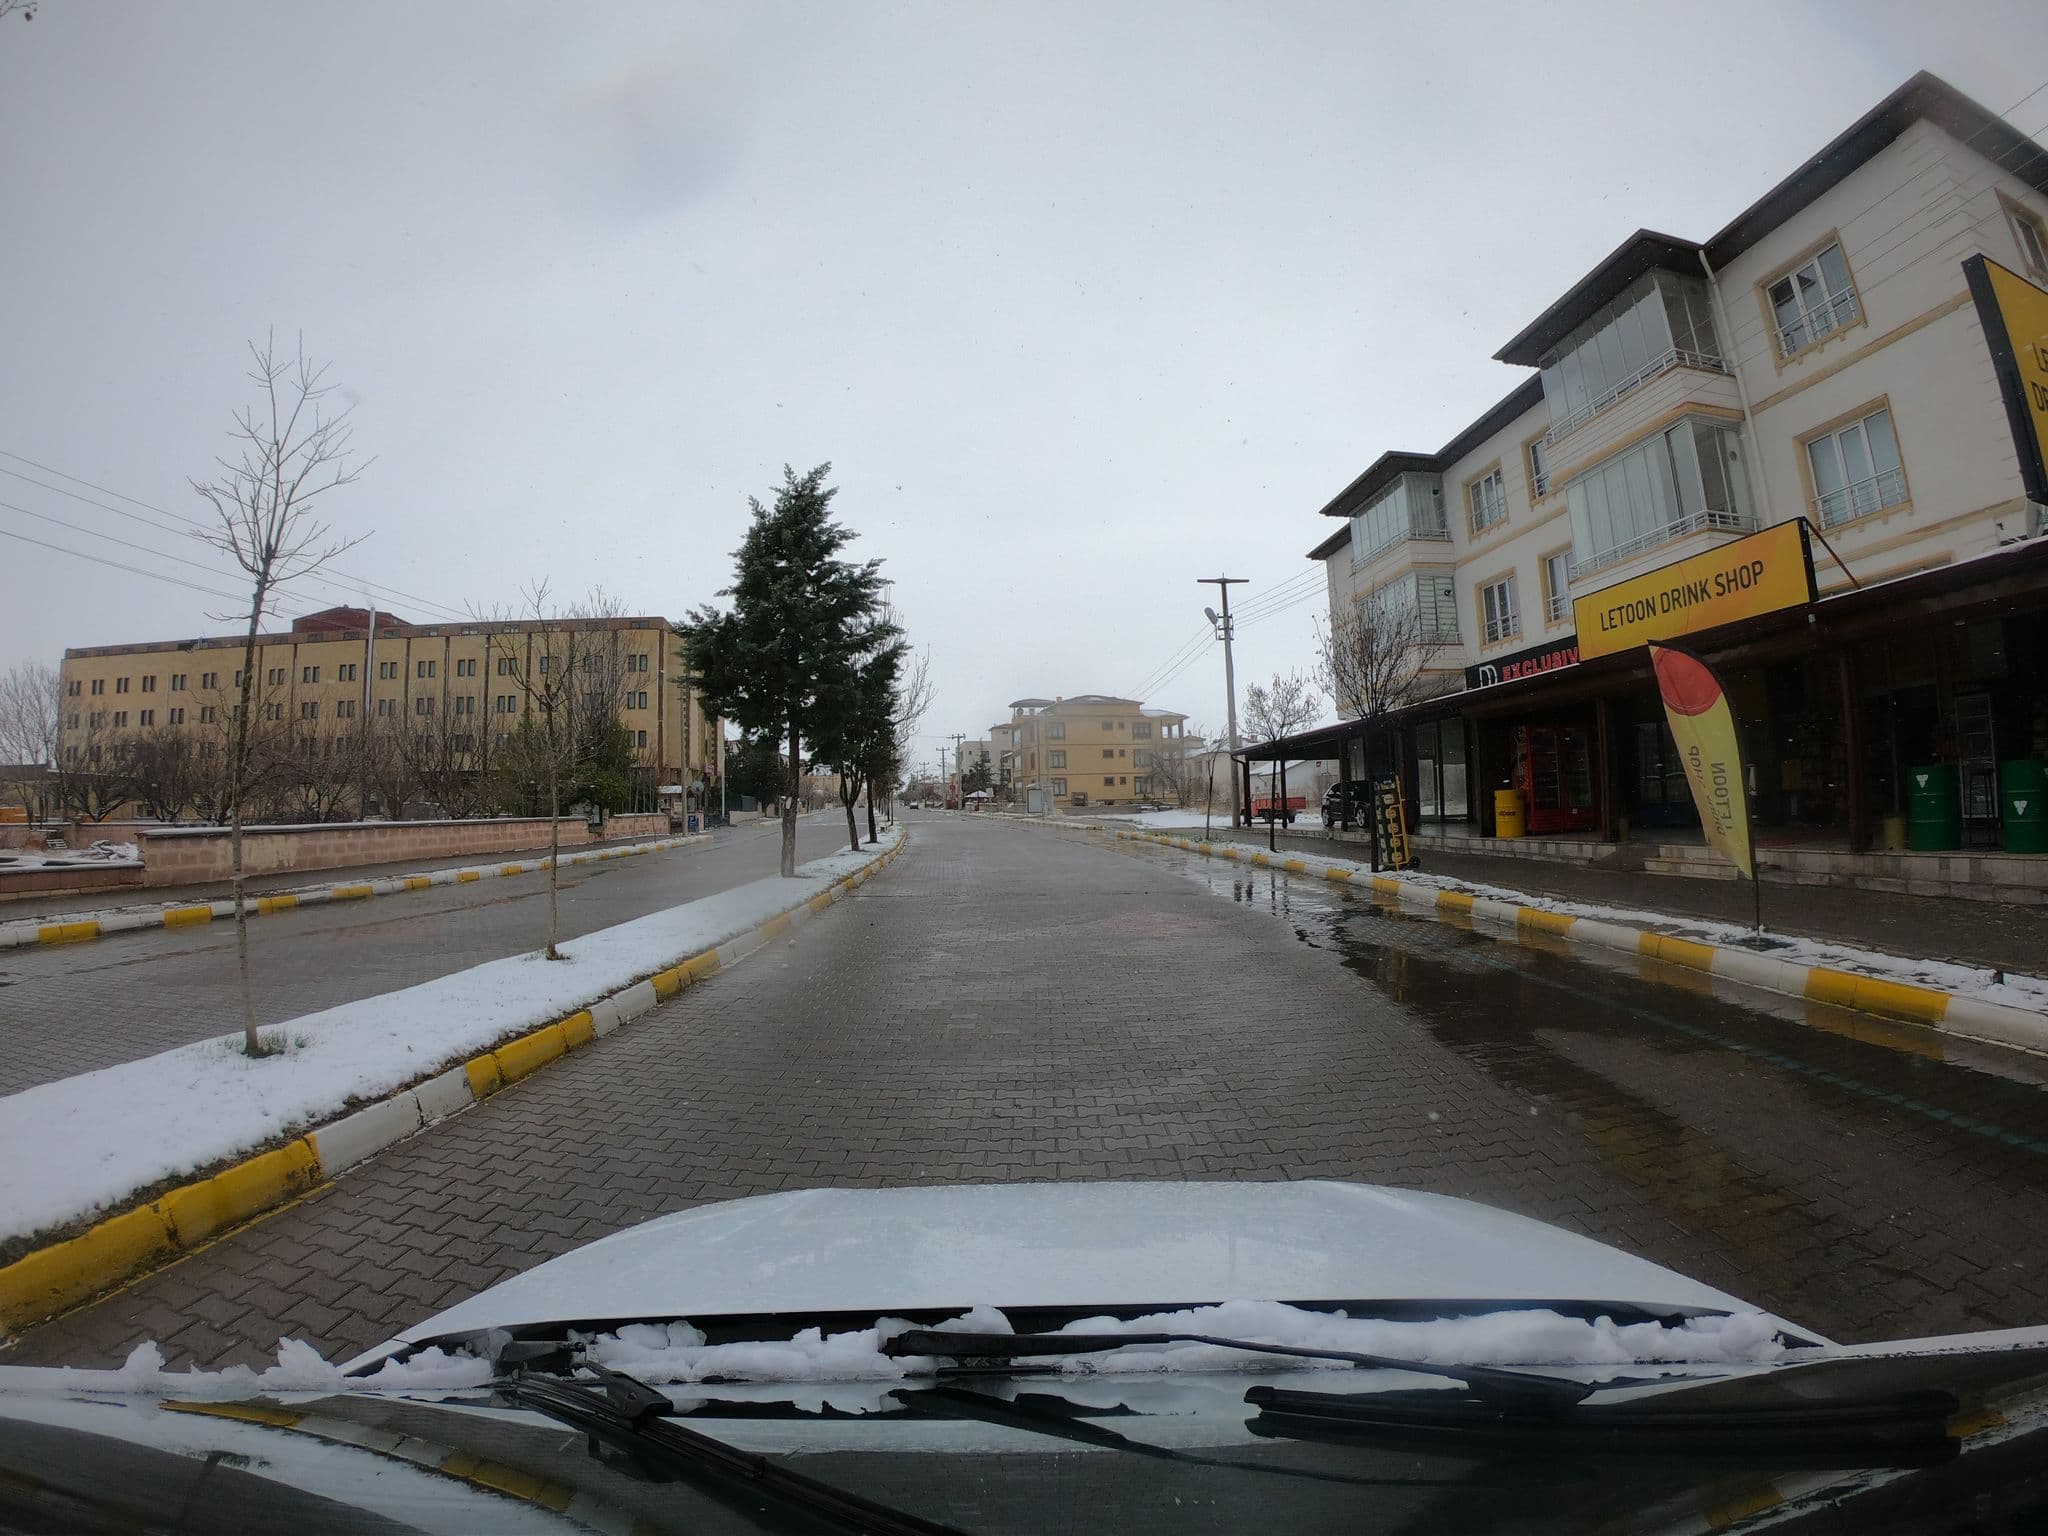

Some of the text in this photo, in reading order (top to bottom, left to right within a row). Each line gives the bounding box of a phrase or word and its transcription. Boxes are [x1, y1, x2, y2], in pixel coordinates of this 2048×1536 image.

[1600, 560, 1764, 632] LETOON DRINK SHOP
